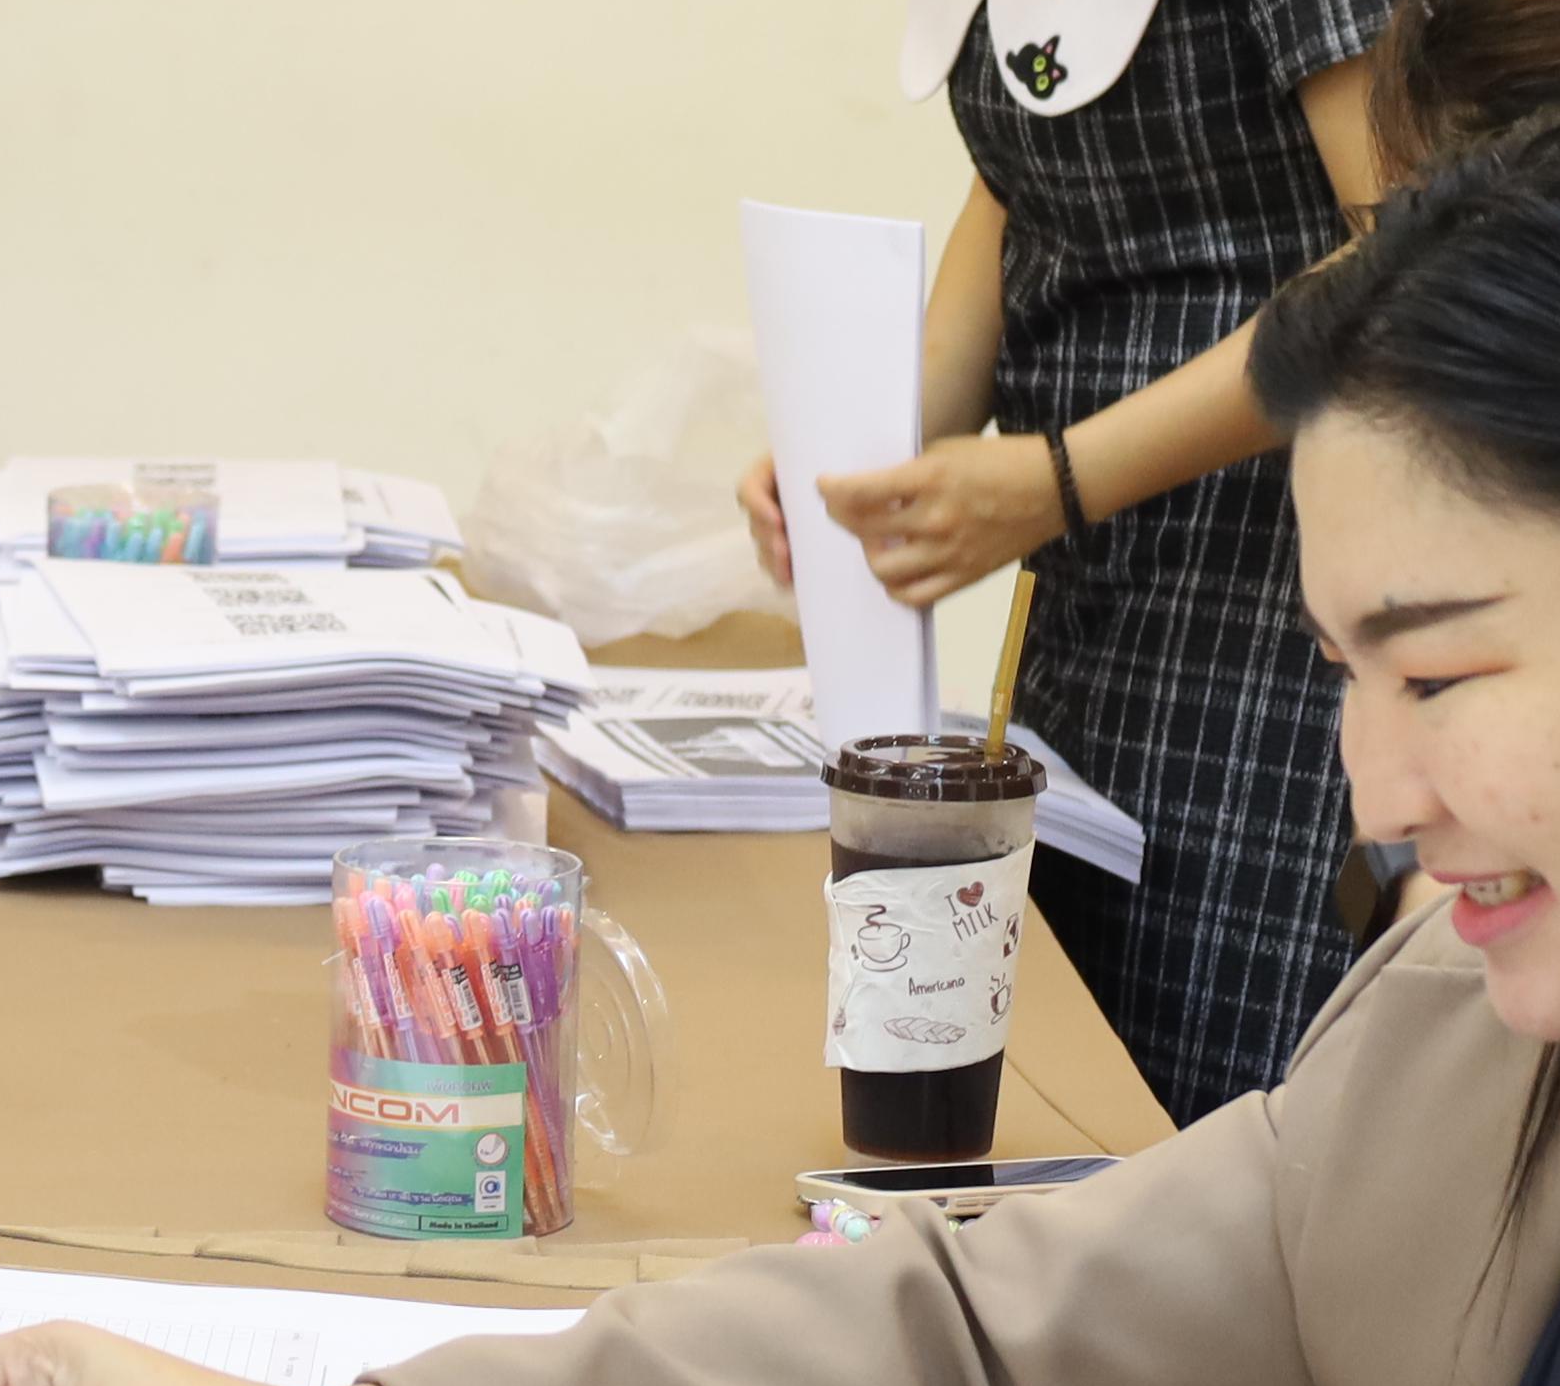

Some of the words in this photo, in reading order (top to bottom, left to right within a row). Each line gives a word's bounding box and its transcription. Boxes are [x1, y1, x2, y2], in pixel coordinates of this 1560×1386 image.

[944, 894, 960, 917] I
[952, 902, 999, 942] MILK
[908, 976, 966, 997] Americano
